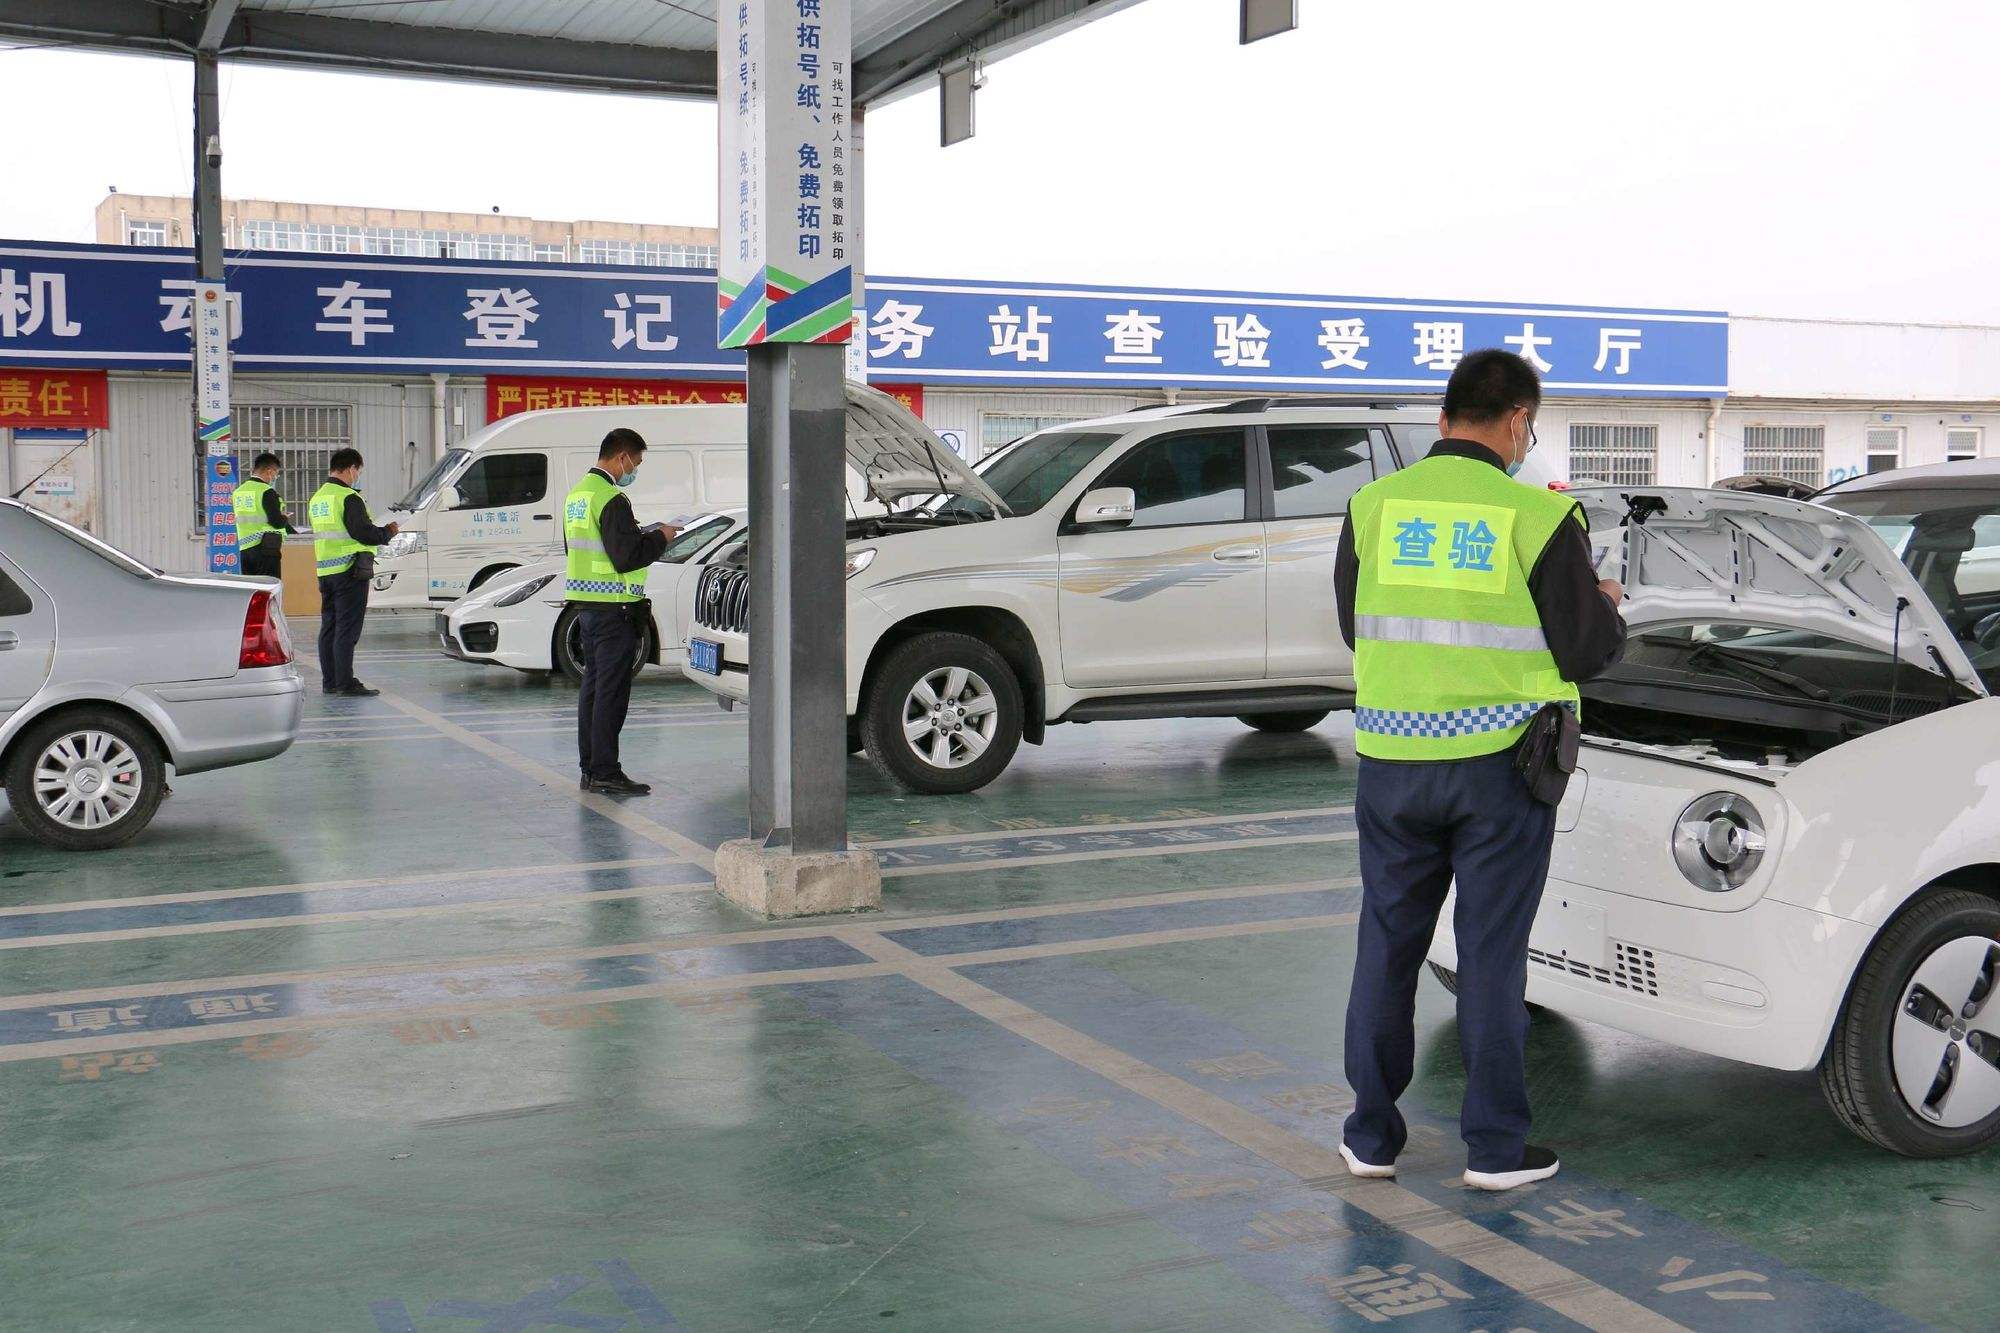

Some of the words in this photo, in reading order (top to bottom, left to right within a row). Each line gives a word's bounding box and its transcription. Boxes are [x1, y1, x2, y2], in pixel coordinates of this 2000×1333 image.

[796, 0, 822, 259] 供拓号纸、免费拓印
[831, 61, 844, 260] 可找工作人员免费领取拓印
[209, 309, 221, 409] 机动车查验区
[311, 502, 329, 517] 查验
[473, 511, 520, 522] 山东临沂
[567, 498, 588, 522] 查验
[214, 553, 237, 567] 中心
[1391, 517, 1498, 572] 查验
